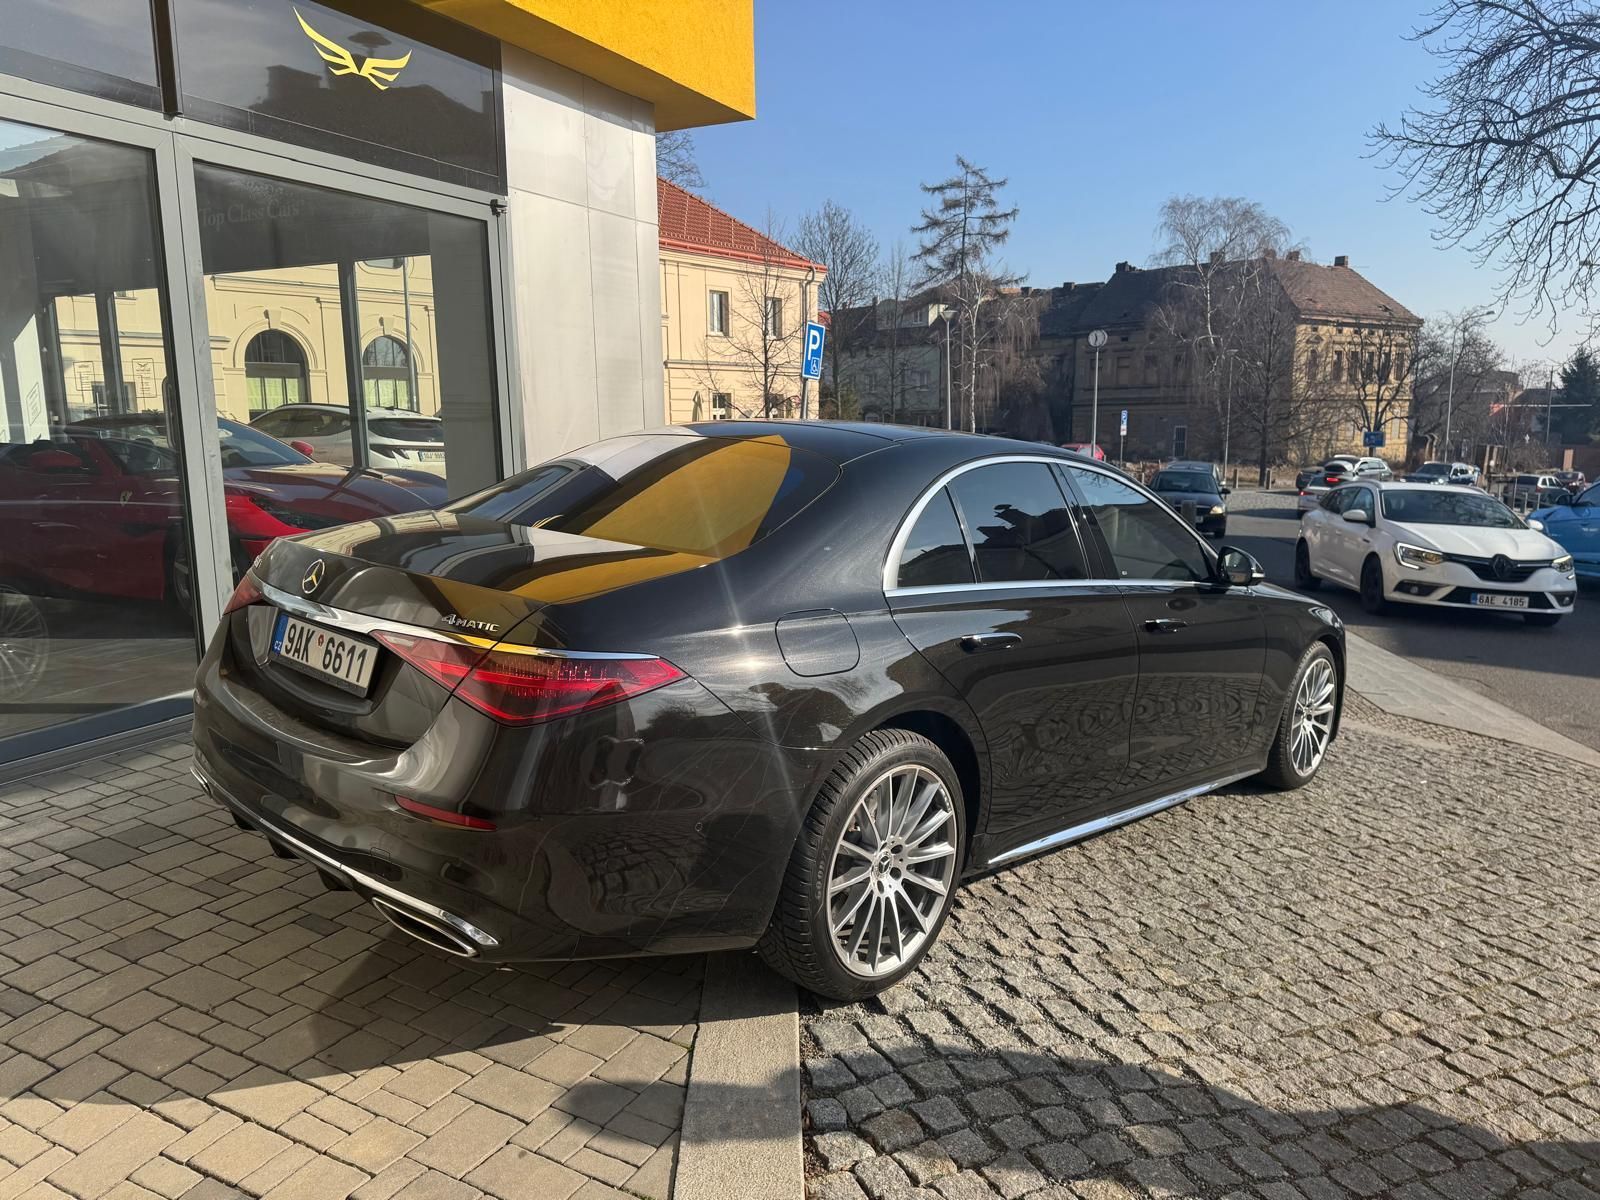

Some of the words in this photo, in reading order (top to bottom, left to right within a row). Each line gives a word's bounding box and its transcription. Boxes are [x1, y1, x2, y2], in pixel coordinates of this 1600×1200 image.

[199, 207, 226, 232] Top
[227, 203, 264, 223] Class
[266, 200, 301, 218] Cars
[808, 329, 820, 360] P
[442, 613, 500, 632] 4MATIC
[274, 640, 282, 651] CZ
[284, 623, 316, 663] 9AK
[322, 637, 368, 683] 6611
